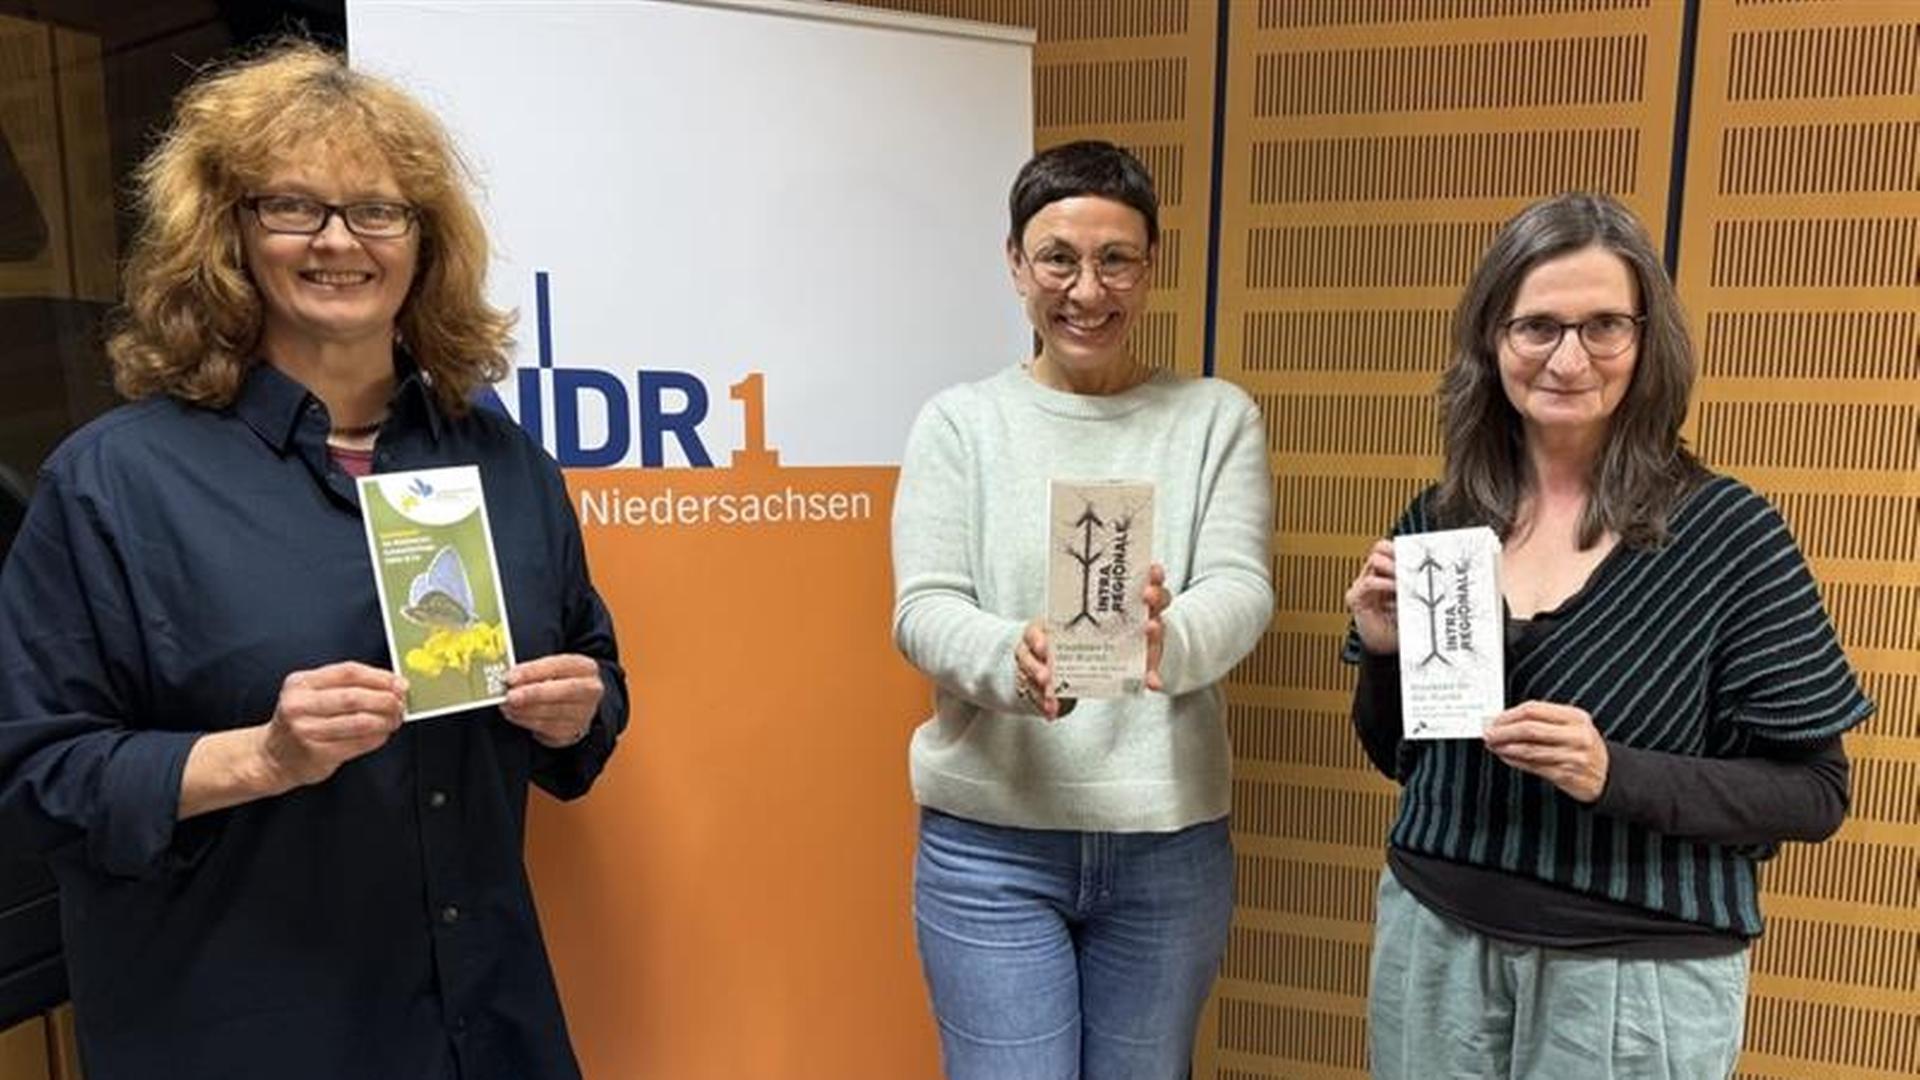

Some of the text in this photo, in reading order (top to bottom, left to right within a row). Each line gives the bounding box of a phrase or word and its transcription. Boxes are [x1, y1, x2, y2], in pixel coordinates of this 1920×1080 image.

[478, 367, 780, 468] NDR 1
[580, 487, 871, 526] Niedersachsen
[1097, 565, 1112, 612] INTRA
[1112, 519, 1130, 614] REGIONALE
[1445, 604, 1458, 652] INTRA
[1455, 561, 1474, 652] REGIONALE
